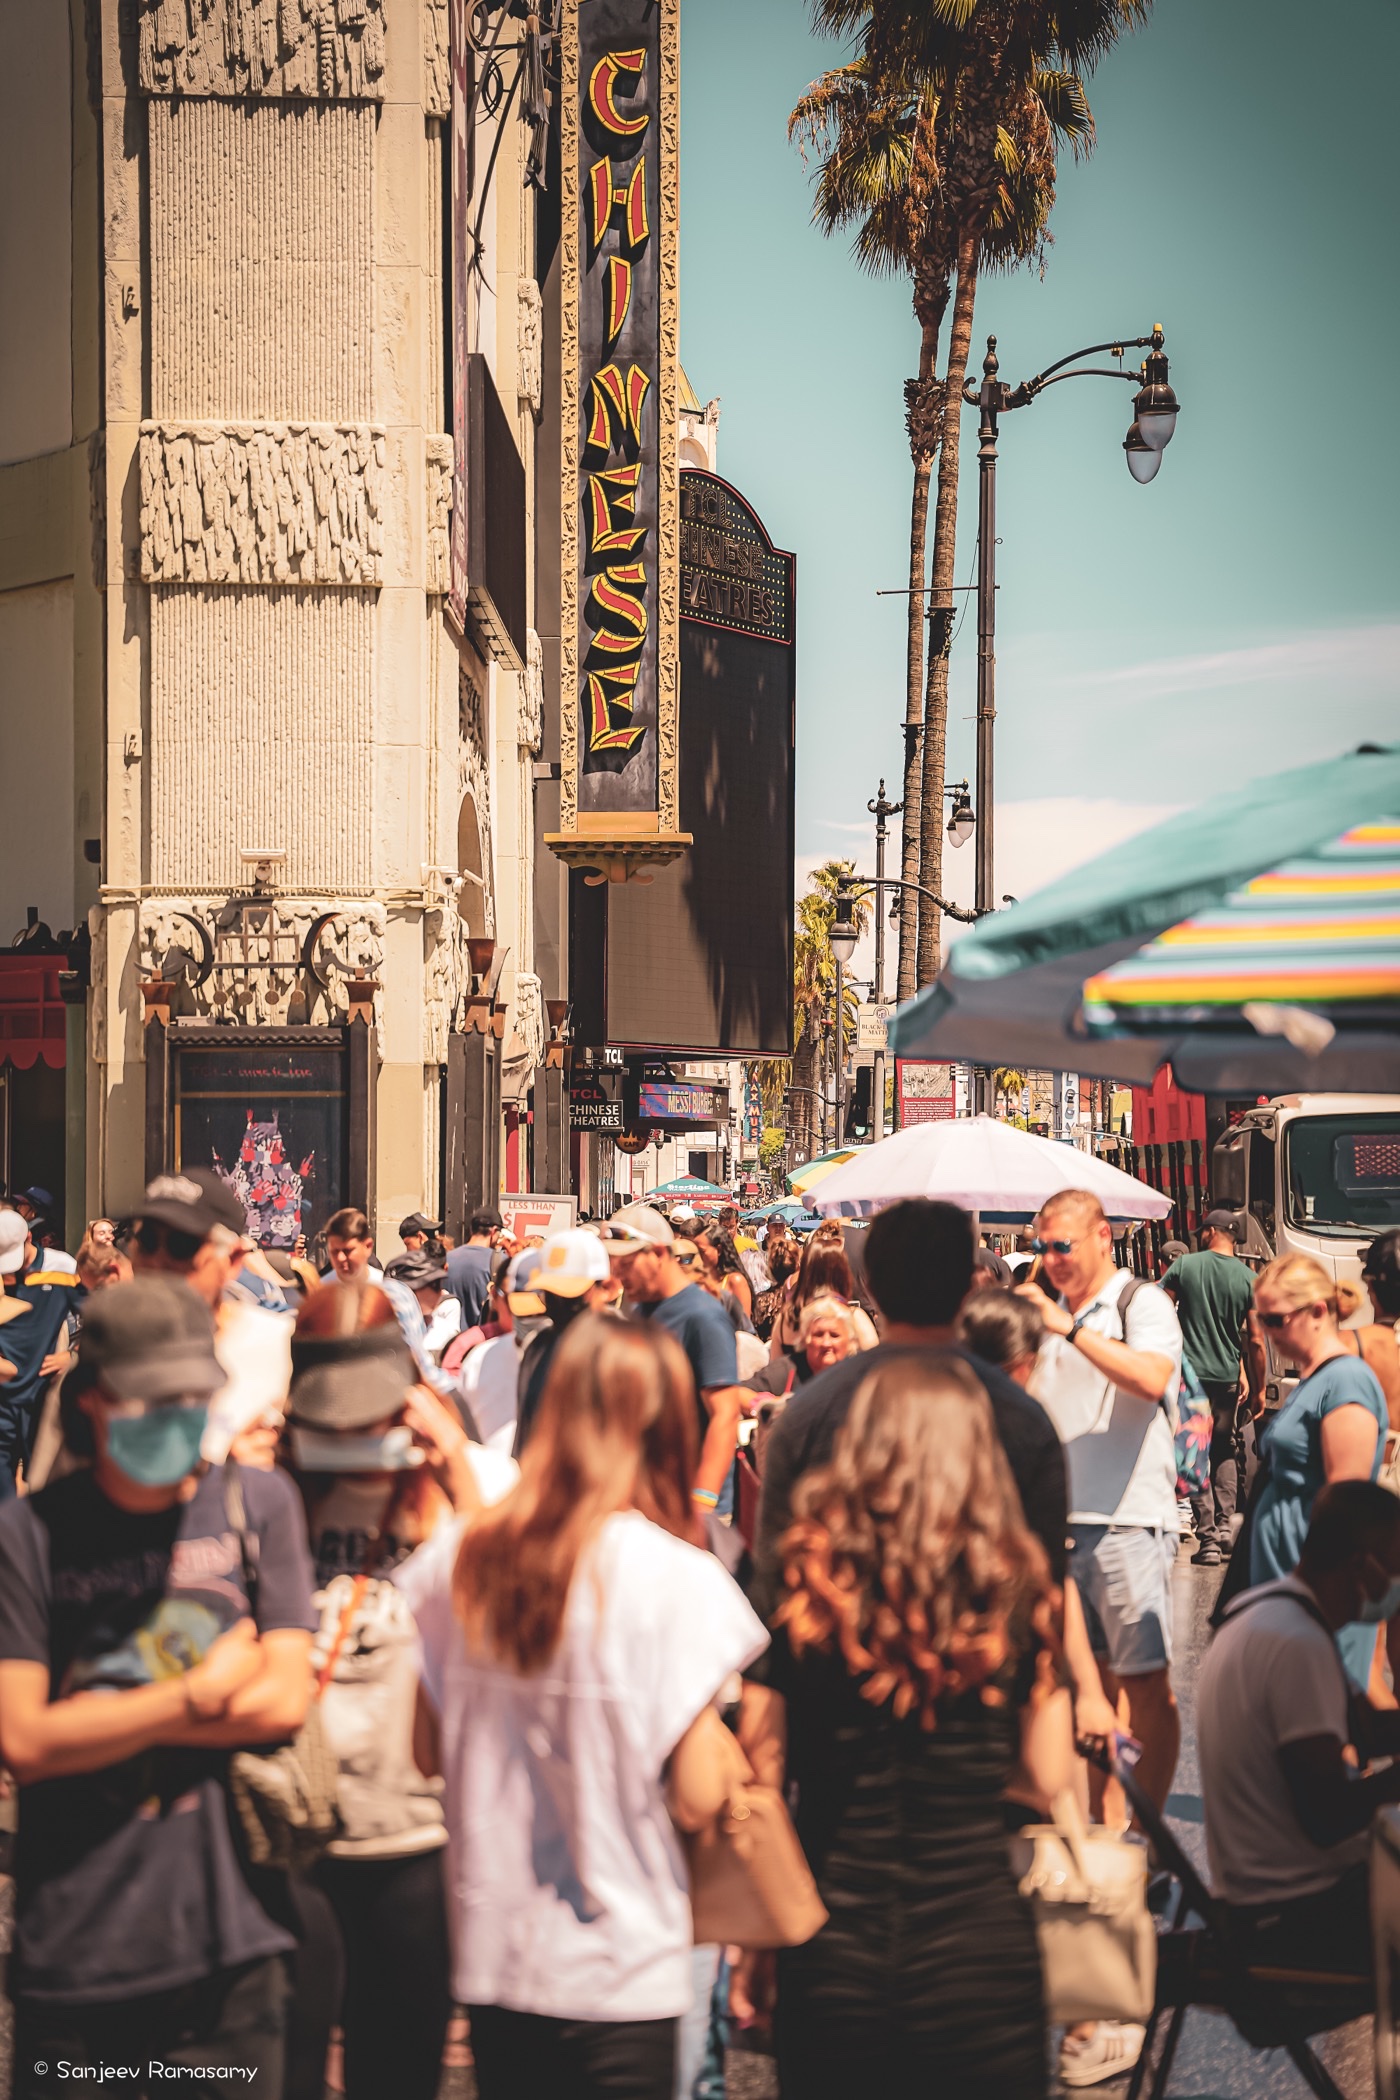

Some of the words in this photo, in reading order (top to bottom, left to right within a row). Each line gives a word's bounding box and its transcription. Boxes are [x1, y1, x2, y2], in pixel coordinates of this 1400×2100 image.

[588, 48, 650, 752] CHINESE
[684, 481, 733, 529] TCL
[680, 525, 764, 582] HINESE
[680, 569, 774, 627] EATRES
[605, 1049, 622, 1063] TCL
[570, 1089, 602, 1099] TCL
[569, 1105, 619, 1115] CHINESE
[569, 1117, 619, 1126] THEATRES
[795, 1152, 805, 1162] M
[508, 1201, 528, 1209] LESS
[532, 1202, 556, 1210] THAN
